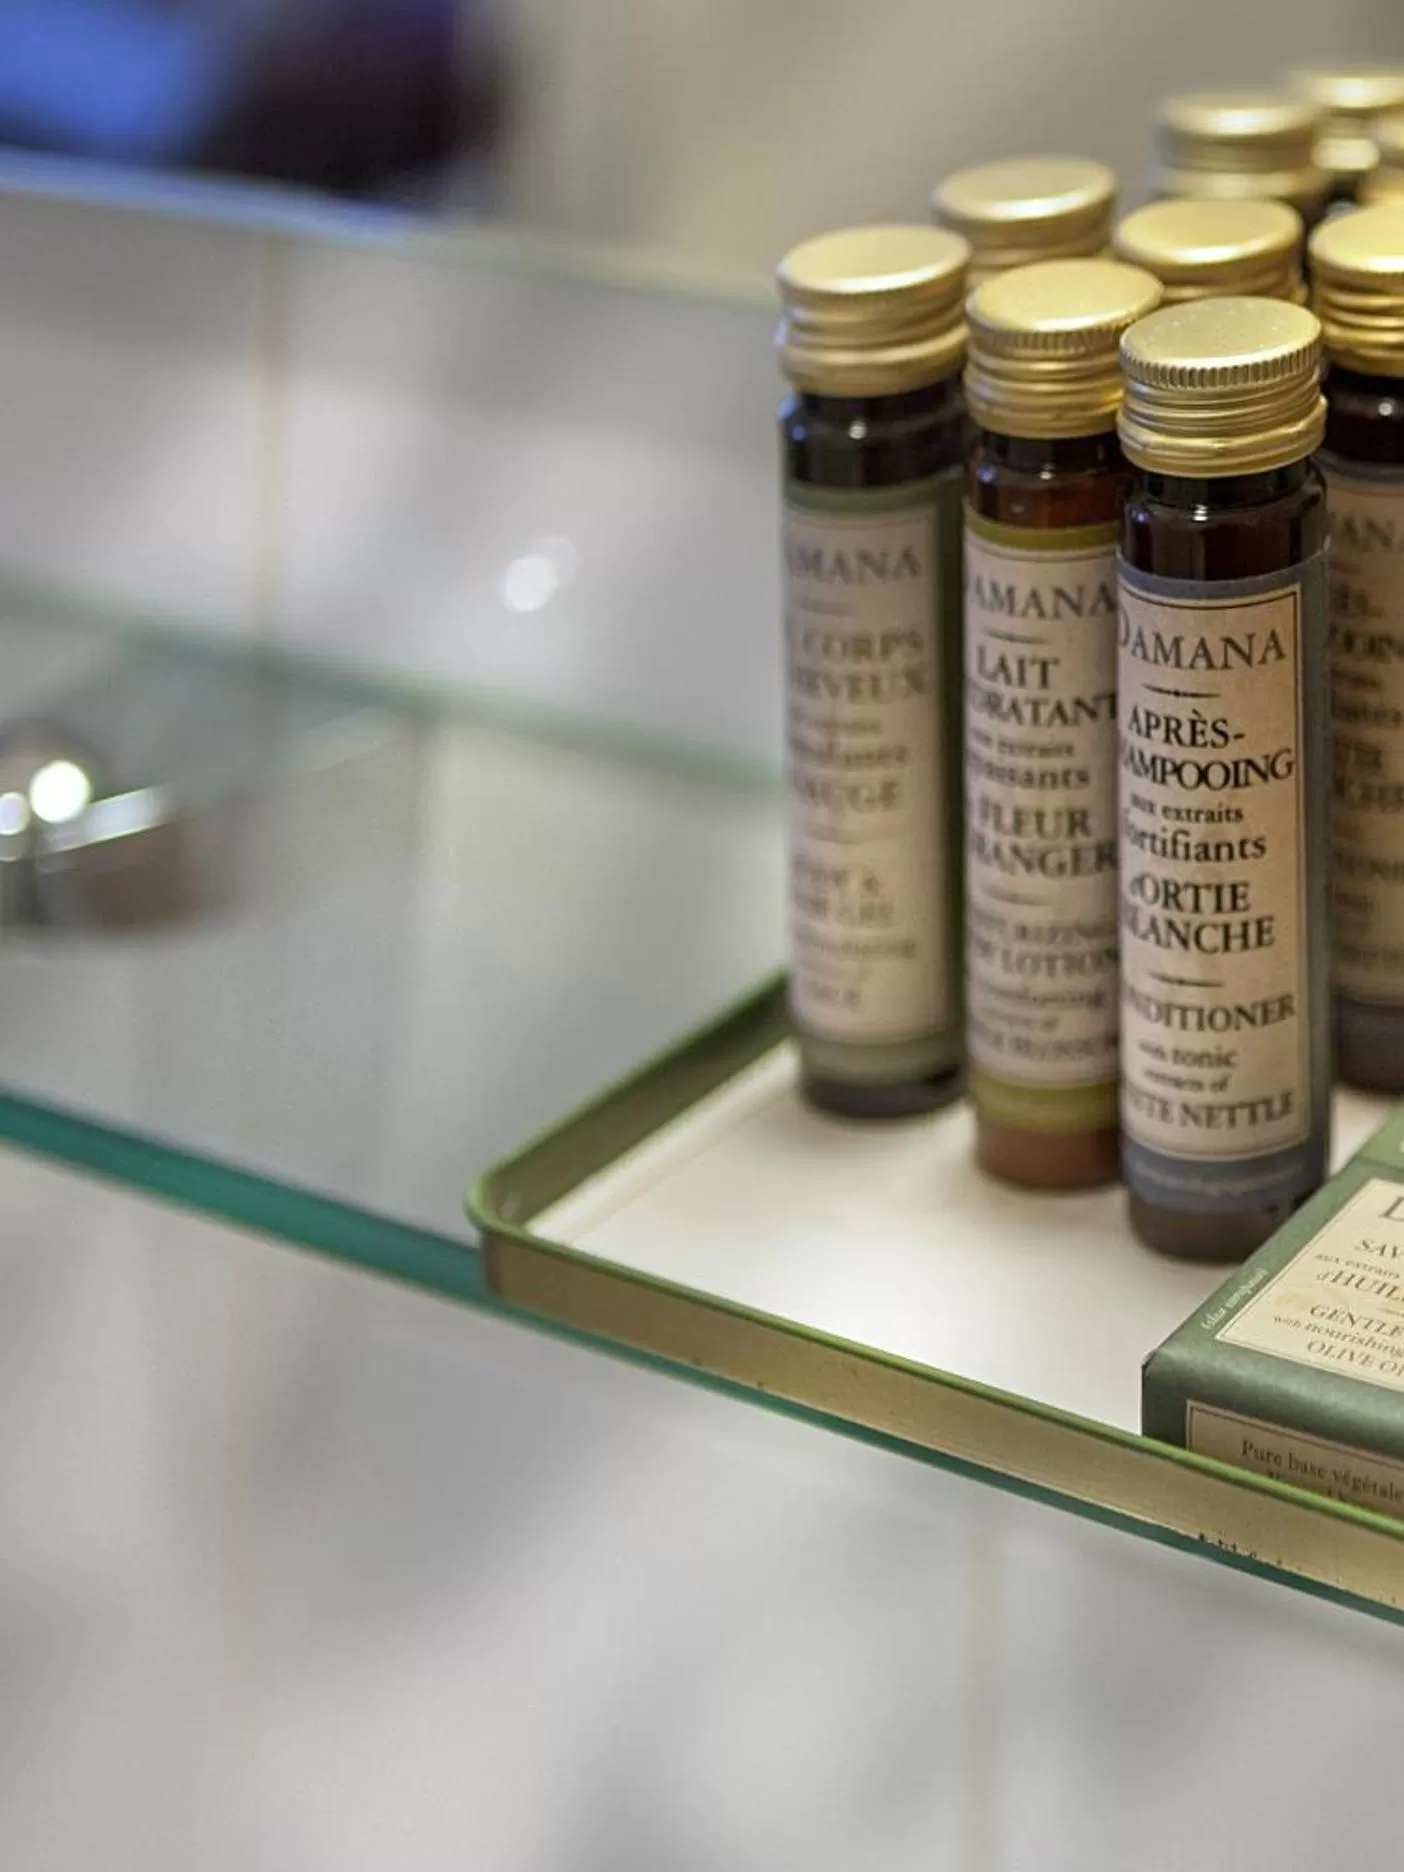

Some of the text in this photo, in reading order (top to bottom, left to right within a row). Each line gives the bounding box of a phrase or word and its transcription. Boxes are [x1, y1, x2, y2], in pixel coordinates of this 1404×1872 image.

[973, 574, 1116, 619] AMANA
[976, 645, 1060, 690] LAIT
[972, 688, 1117, 728] RATANT
[1128, 704, 1246, 748] APRÈS-
[1123, 746, 1295, 790] AMPOOING
[1161, 802, 1244, 823] extraits
[1126, 912, 1276, 954] LANCHE
[1131, 991, 1296, 1032] DITIONER
[1179, 1089, 1295, 1129] NETTLE
[1307, 1339, 1375, 1369] OLIVE
[1242, 1439, 1282, 1466] Pure
